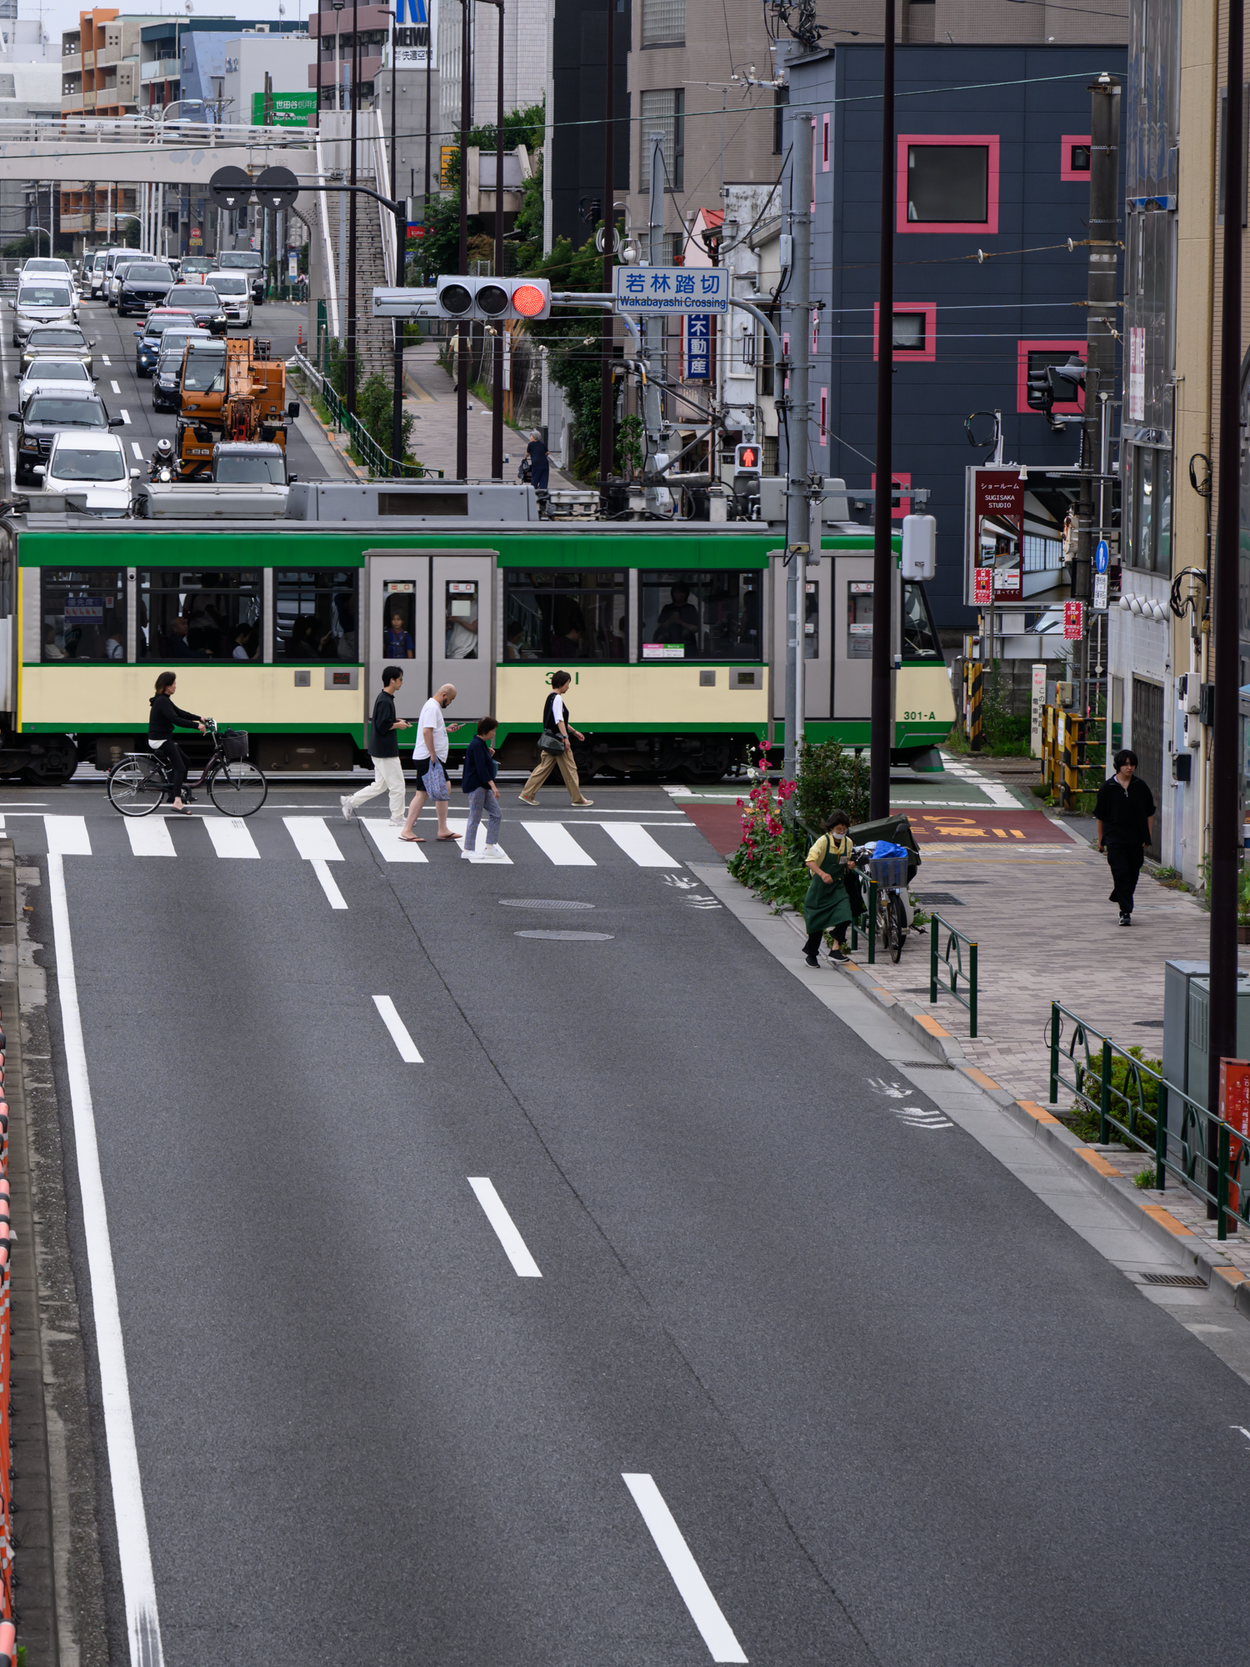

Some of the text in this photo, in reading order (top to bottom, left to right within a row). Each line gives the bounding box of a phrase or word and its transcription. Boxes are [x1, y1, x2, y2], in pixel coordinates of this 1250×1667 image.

[625, 273, 720, 294] 若林踏切
[620, 295, 726, 310] Wakabayashi Crossing
[981, 482, 1020, 490] ショールーム
[545, 672, 579, 685] 31
[903, 711, 936, 720] 301-A
